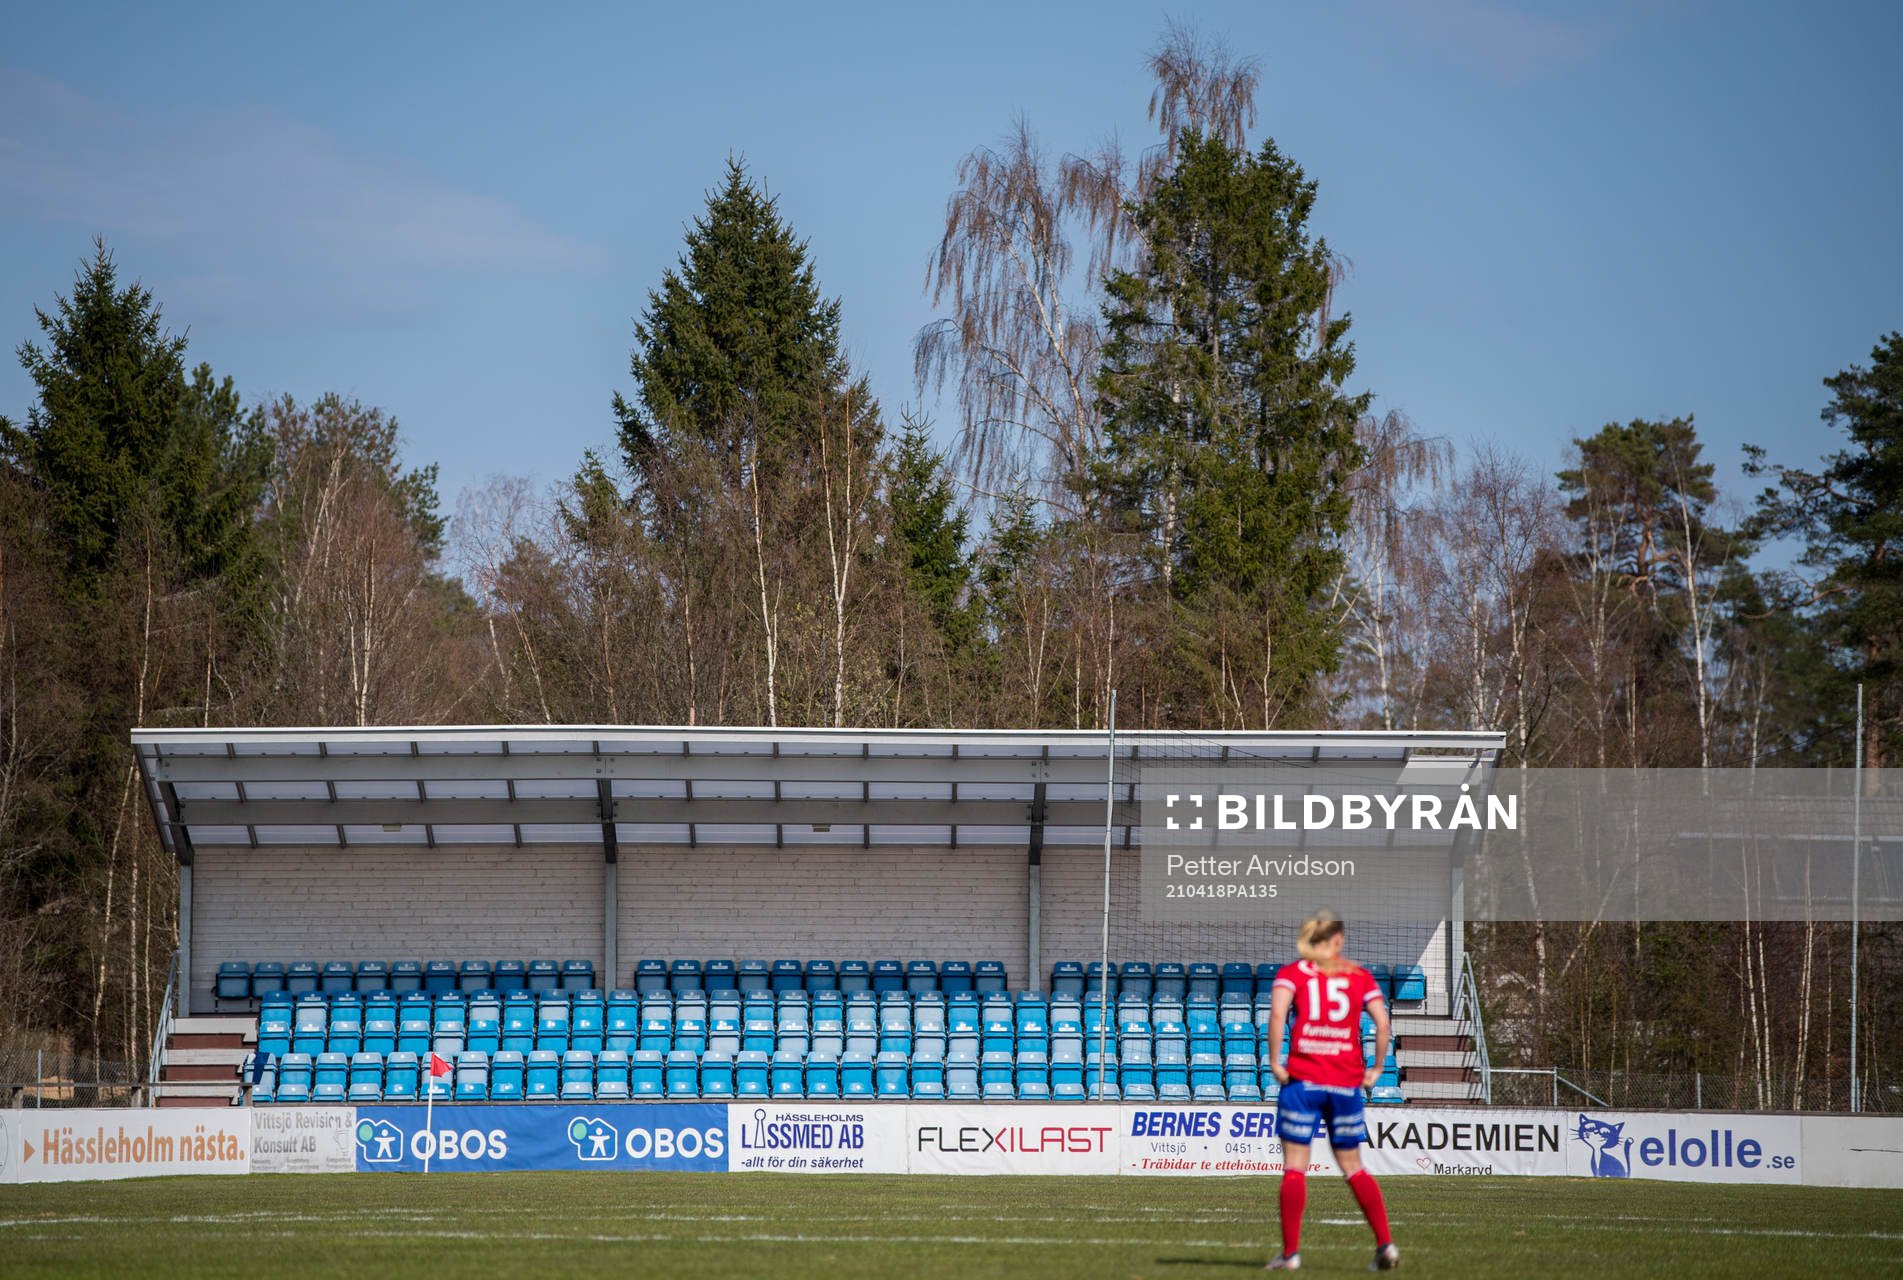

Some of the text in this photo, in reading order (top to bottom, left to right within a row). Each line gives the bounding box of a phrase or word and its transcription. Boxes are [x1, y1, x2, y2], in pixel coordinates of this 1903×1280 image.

[1308, 977, 1350, 1022] 15
[255, 1112, 292, 1133] Vittsjö
[344, 1112, 352, 1128] &
[775, 1113, 864, 1122] HÄSSLEHOLMS
[1131, 1112, 1222, 1137] BERNES
[43, 1125, 245, 1165] Hässleholm nästa.
[301, 1136, 317, 1153] AB
[411, 1129, 507, 1160] OBOS
[625, 1128, 724, 1159] OBOS
[838, 1124, 864, 1149] AB
[918, 1127, 1113, 1153] FLEXILAST
[1150, 1142, 1187, 1155] Vittsjö
[1225, 1143, 1251, 1153] 0451
[767, 1157, 785, 1169] för
[788, 1157, 807, 1168] din
[810, 1157, 864, 1169] säkerhet
[1141, 1158, 1197, 1170] Träbidar
